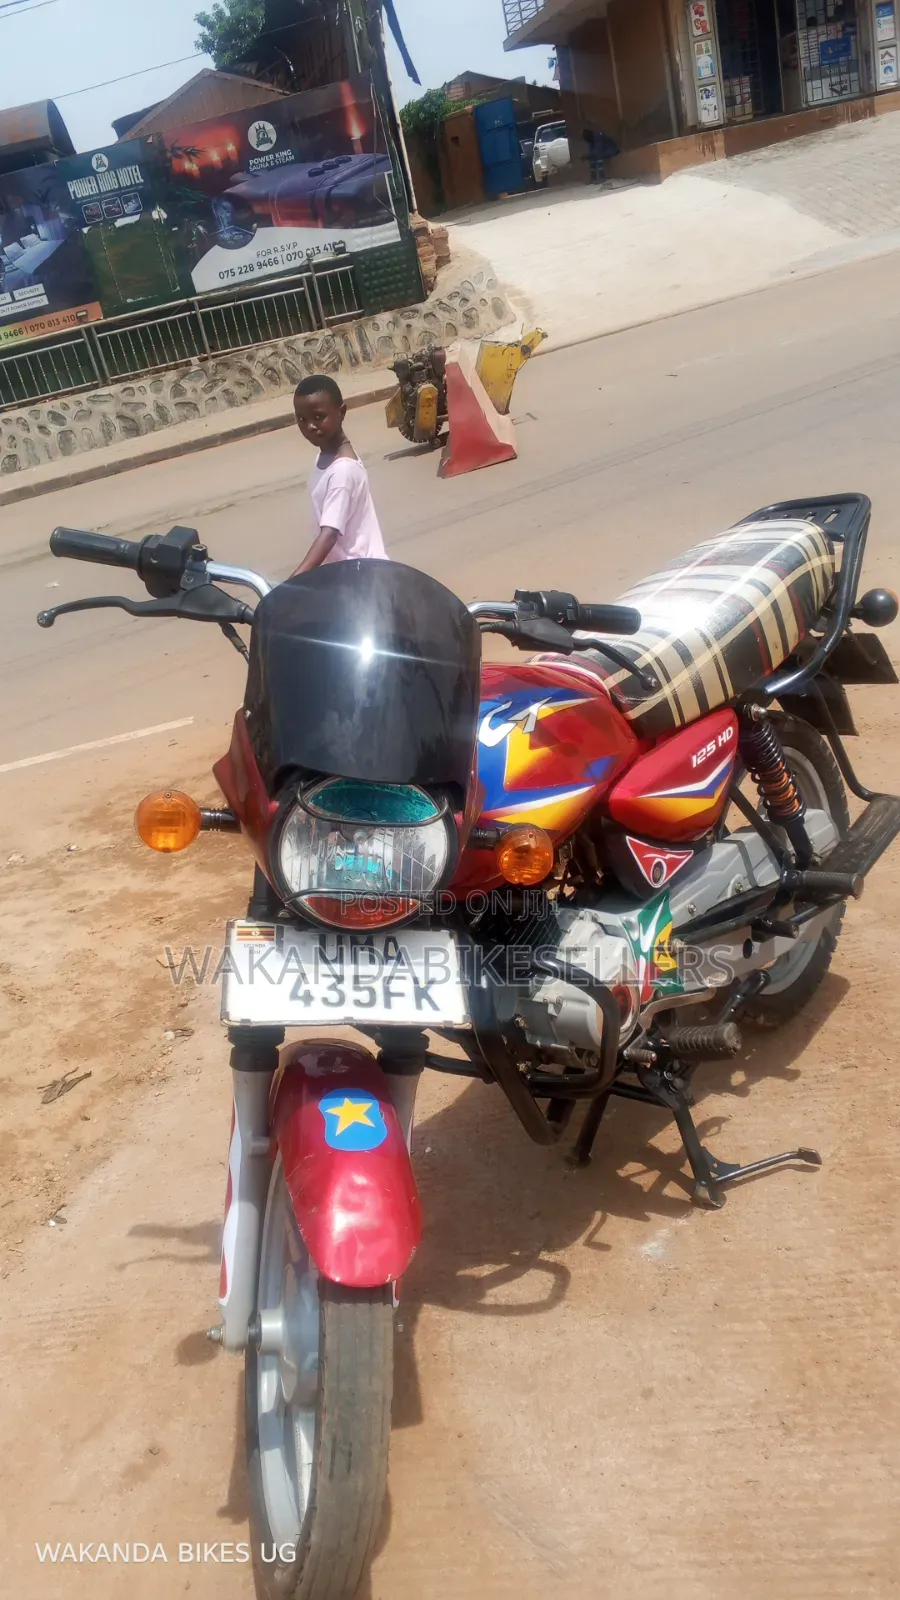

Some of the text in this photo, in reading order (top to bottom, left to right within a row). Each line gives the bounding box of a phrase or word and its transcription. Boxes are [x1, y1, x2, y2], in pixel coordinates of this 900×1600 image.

[249, 149, 292, 166] POWER KING
[249, 162, 270, 171] SAUNA
[275, 155, 295, 165] STEAM
[67, 176, 99, 200] POWER
[116, 164, 145, 189] HOTEL
[256, 248, 272, 259] FOR
[218, 269, 236, 280] 075
[238, 263, 255, 275] 228
[256, 256, 280, 270] 9466
[286, 250, 304, 262] 070
[18, 287, 40, 297] SECURITY
[11, 303, 27, 311] POWER
[27, 299, 44, 307] SUPPLY
[3, 327, 24, 339] 9466
[29, 322, 46, 333] 070
[692, 726, 734, 768] 125 HD
[289, 972, 441, 1012] 435FK
